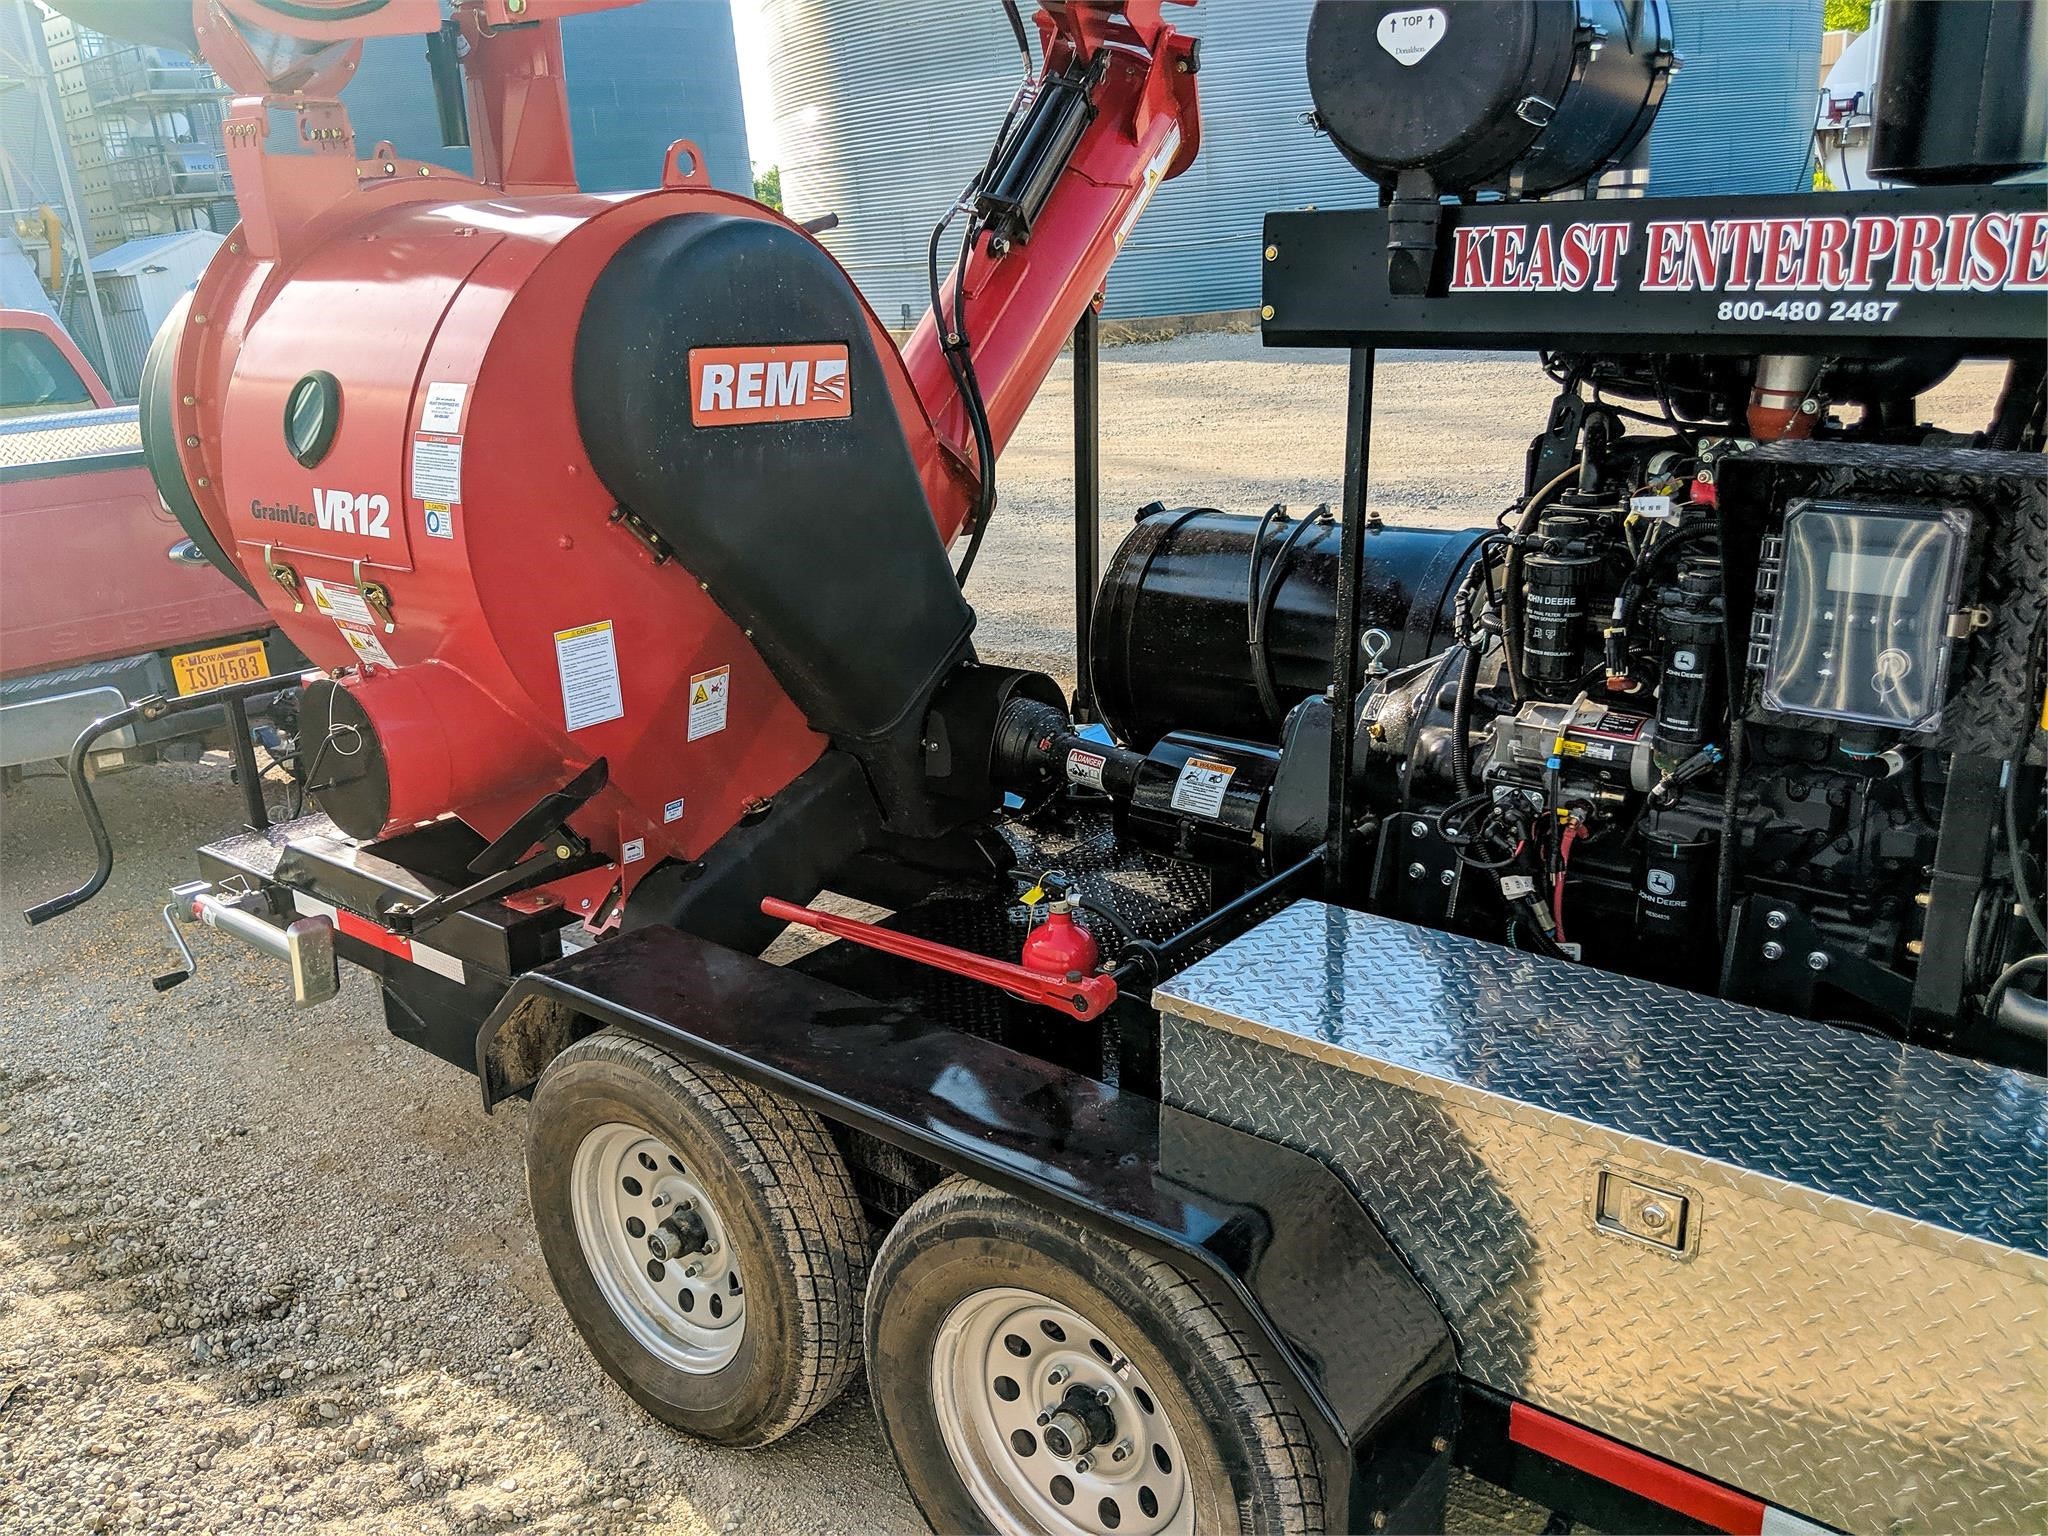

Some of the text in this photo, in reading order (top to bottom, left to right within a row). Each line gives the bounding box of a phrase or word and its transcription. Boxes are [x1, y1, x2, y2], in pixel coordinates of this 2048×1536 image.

[1402, 15, 1423, 27] TOP
[1395, 46, 1426, 55] Donaldson
[1449, 222, 1631, 292] KEAST
[1717, 301, 1898, 321] 800-480 2487
[700, 361, 809, 411] REM
[251, 487, 391, 539] GrainVac VR12
[1544, 597, 1577, 606] DEERE
[576, 626, 598, 635] CAUTION
[185, 655, 260, 690] ISU4583
[1666, 668, 1703, 679] JOHN DEERE
[1077, 754, 1102, 768] DANGER
[1638, 889, 1687, 907] JOHN DEERE
